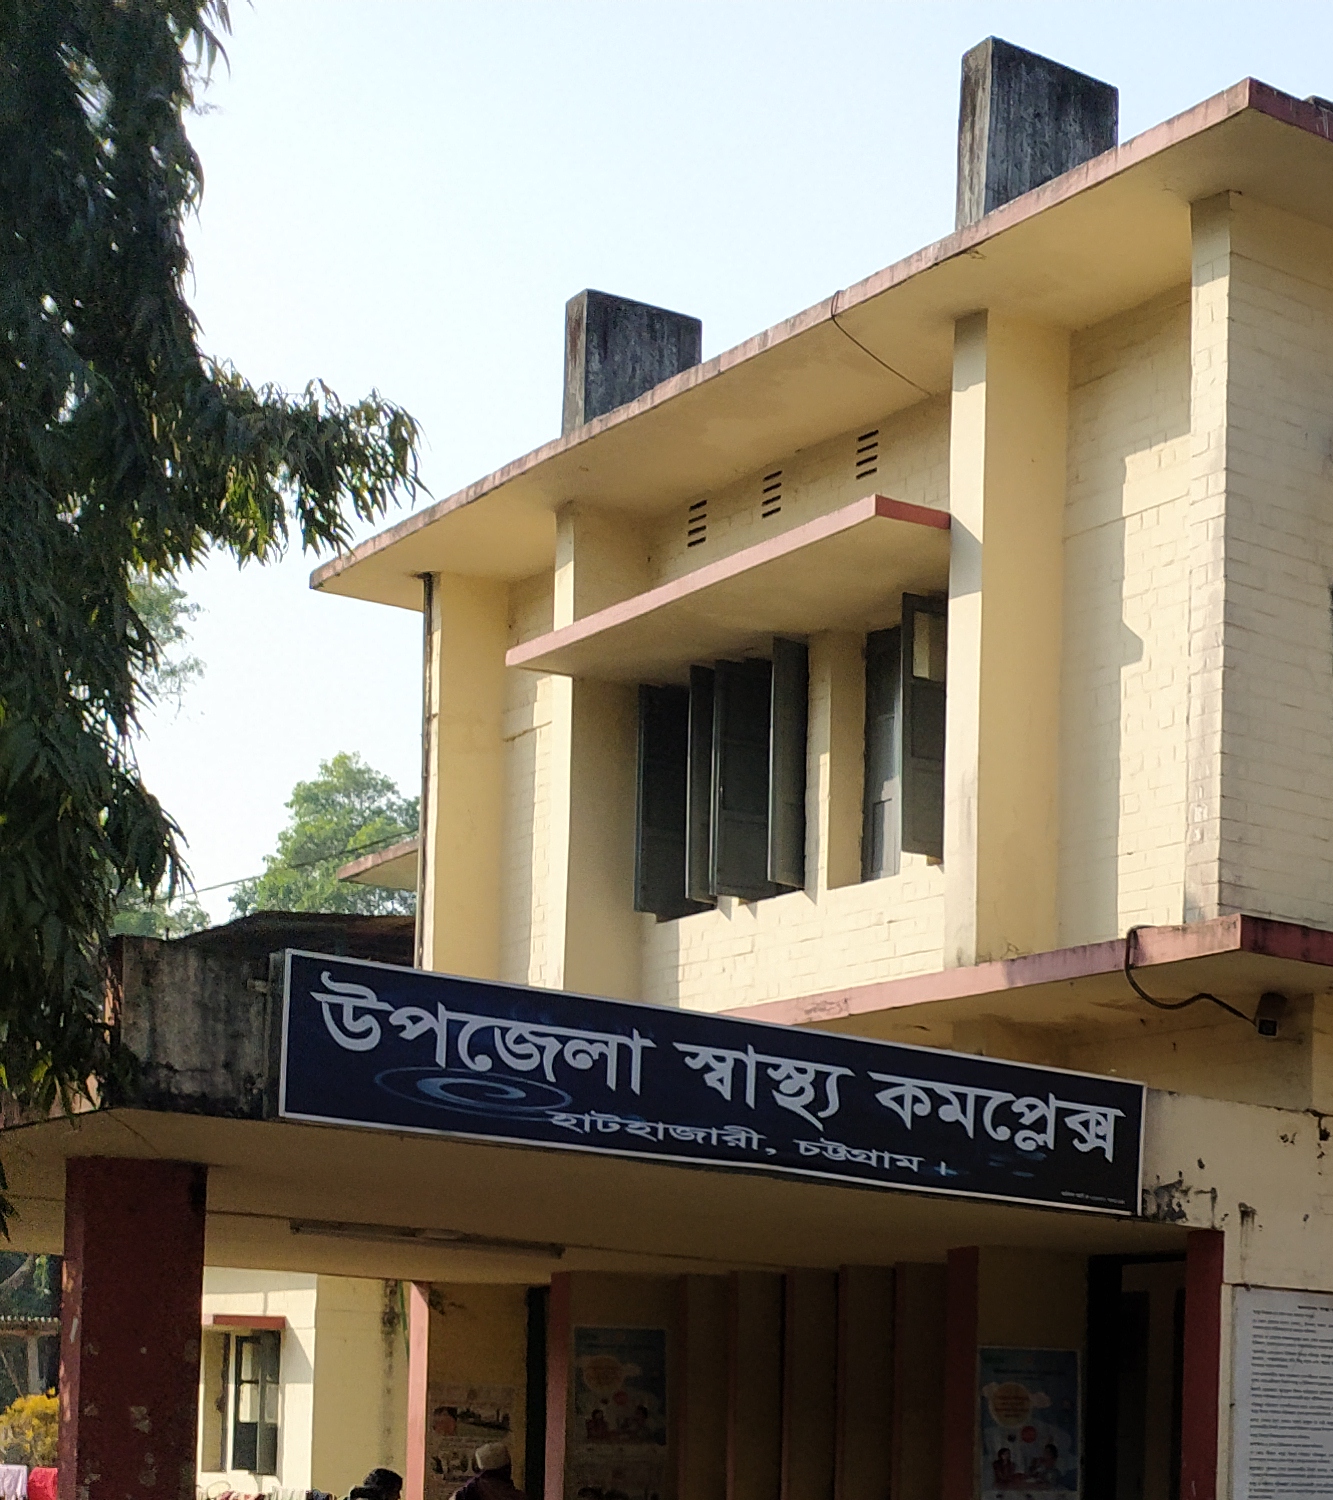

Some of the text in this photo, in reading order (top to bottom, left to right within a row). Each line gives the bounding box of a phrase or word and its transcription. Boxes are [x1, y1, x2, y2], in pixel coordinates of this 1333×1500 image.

[310, 971, 1127, 1164] উপজেলা স্বাস্থ্য কমপ্লেক্স
[545, 1110, 777, 1156] হাটহাজারী,
[793, 1137, 925, 1173] চট্টগ্রাম
